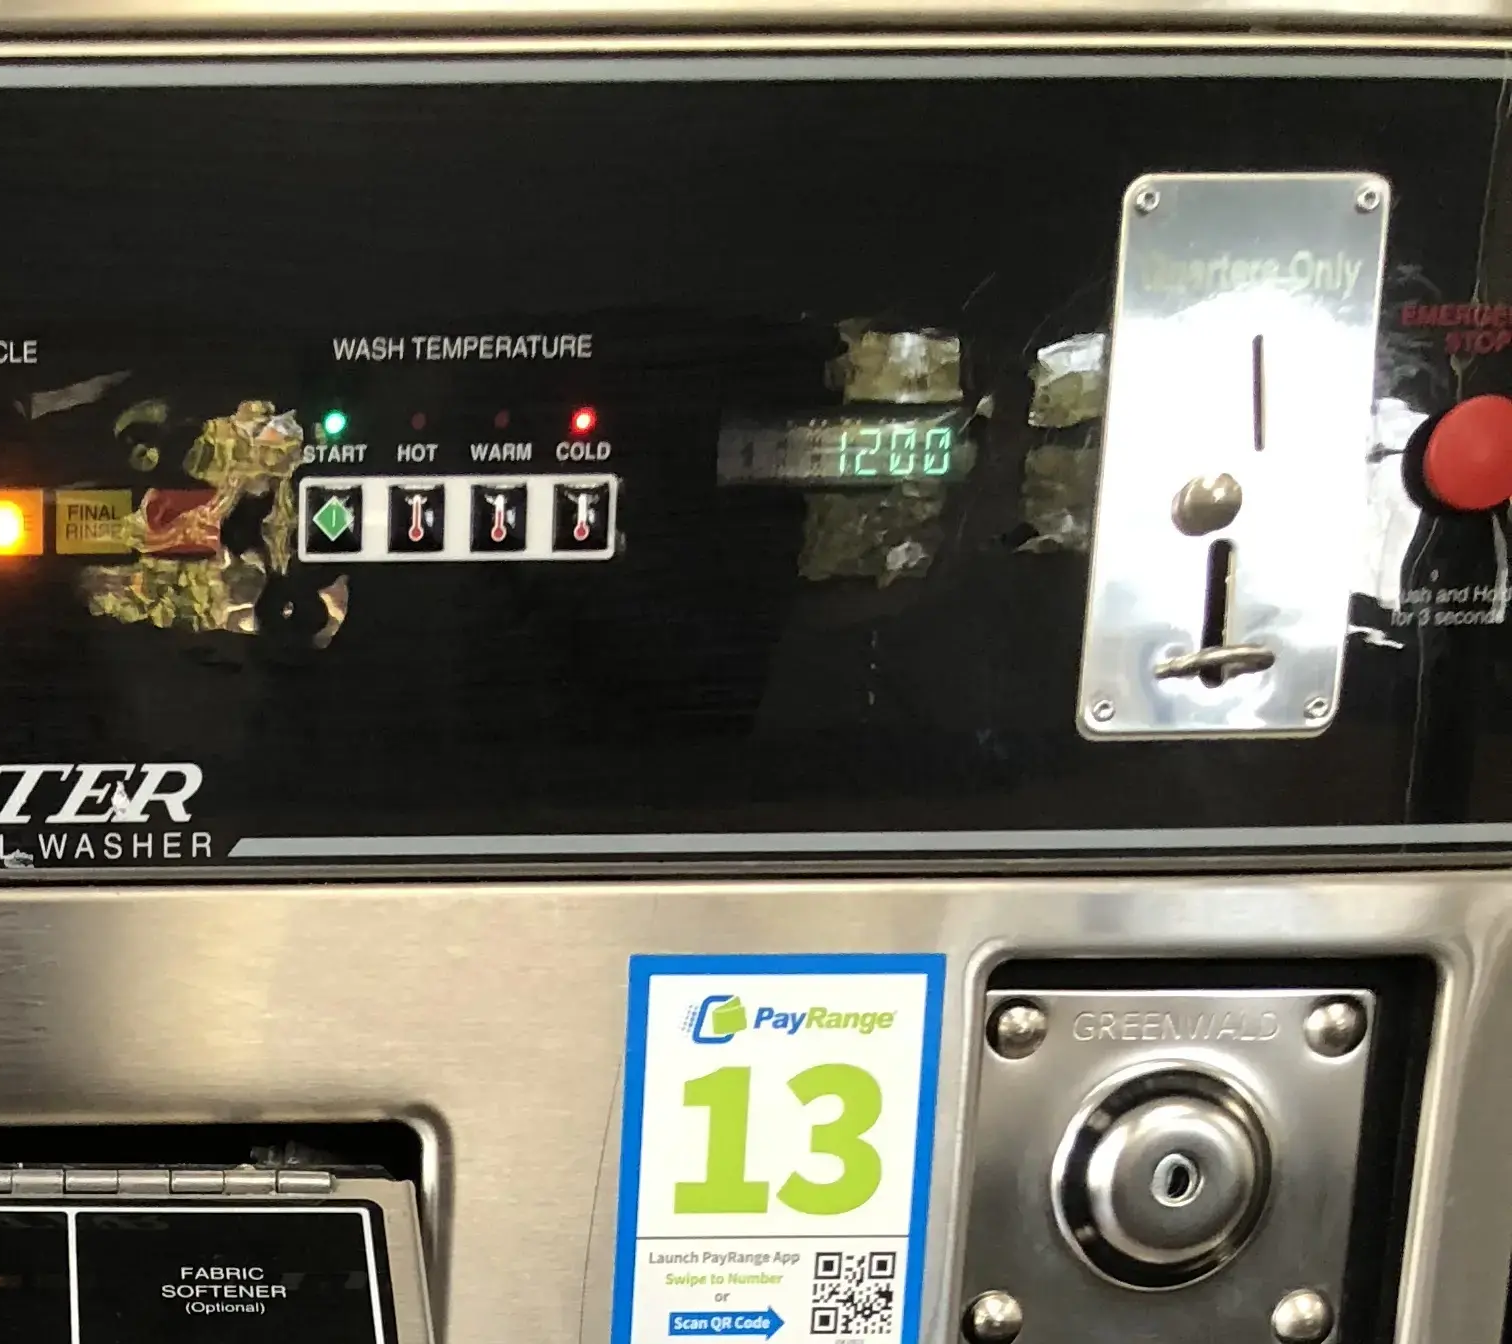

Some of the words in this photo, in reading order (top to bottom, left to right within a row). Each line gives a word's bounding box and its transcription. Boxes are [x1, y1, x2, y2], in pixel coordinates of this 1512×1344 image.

[333, 338, 404, 361] WASH
[412, 335, 593, 361] TEMPERATURE
[302, 444, 367, 462] START
[397, 443, 438, 462] HOT
[469, 442, 532, 462] WARM
[556, 441, 611, 461] COLD
[67, 505, 121, 522] FINAL
[40, 833, 212, 859] WASHER
[753, 1007, 894, 1035] PayRange
[1072, 1011, 1279, 1042] GREENWALD
[673, 1062, 882, 1215] 13
[649, 1251, 698, 1264] Launch
[702, 1251, 770, 1265] PayRange
[773, 1252, 800, 1264] App
[181, 1268, 263, 1280] FABRIC
[665, 1273, 708, 1287] Swipe
[711, 1273, 724, 1285] to
[728, 1273, 783, 1284] Number
[161, 1285, 286, 1298] SOFTENER
[715, 1291, 729, 1302] or
[185, 1302, 265, 1314] (Optional)
[674, 1316, 708, 1330] Scan
[711, 1316, 729, 1331] QR
[732, 1316, 770, 1329] Code
